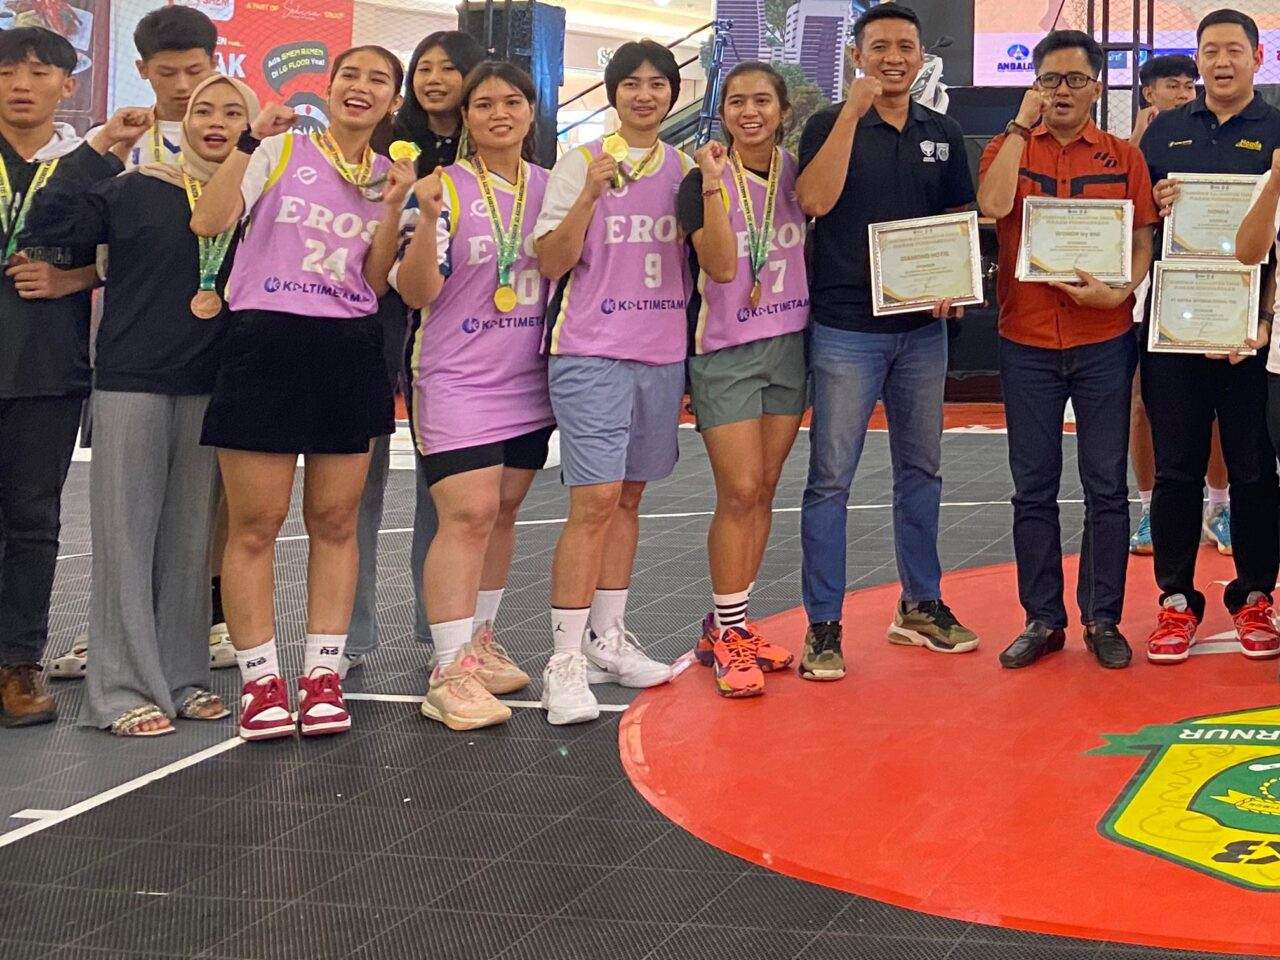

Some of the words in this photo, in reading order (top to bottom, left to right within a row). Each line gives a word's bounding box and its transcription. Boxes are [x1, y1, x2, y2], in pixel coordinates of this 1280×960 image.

[274, 196, 383, 245] EROS
[604, 215, 684, 245] ERO
[301, 238, 349, 282] 24
[644, 253, 662, 289] 9
[769, 260, 788, 294] 7
